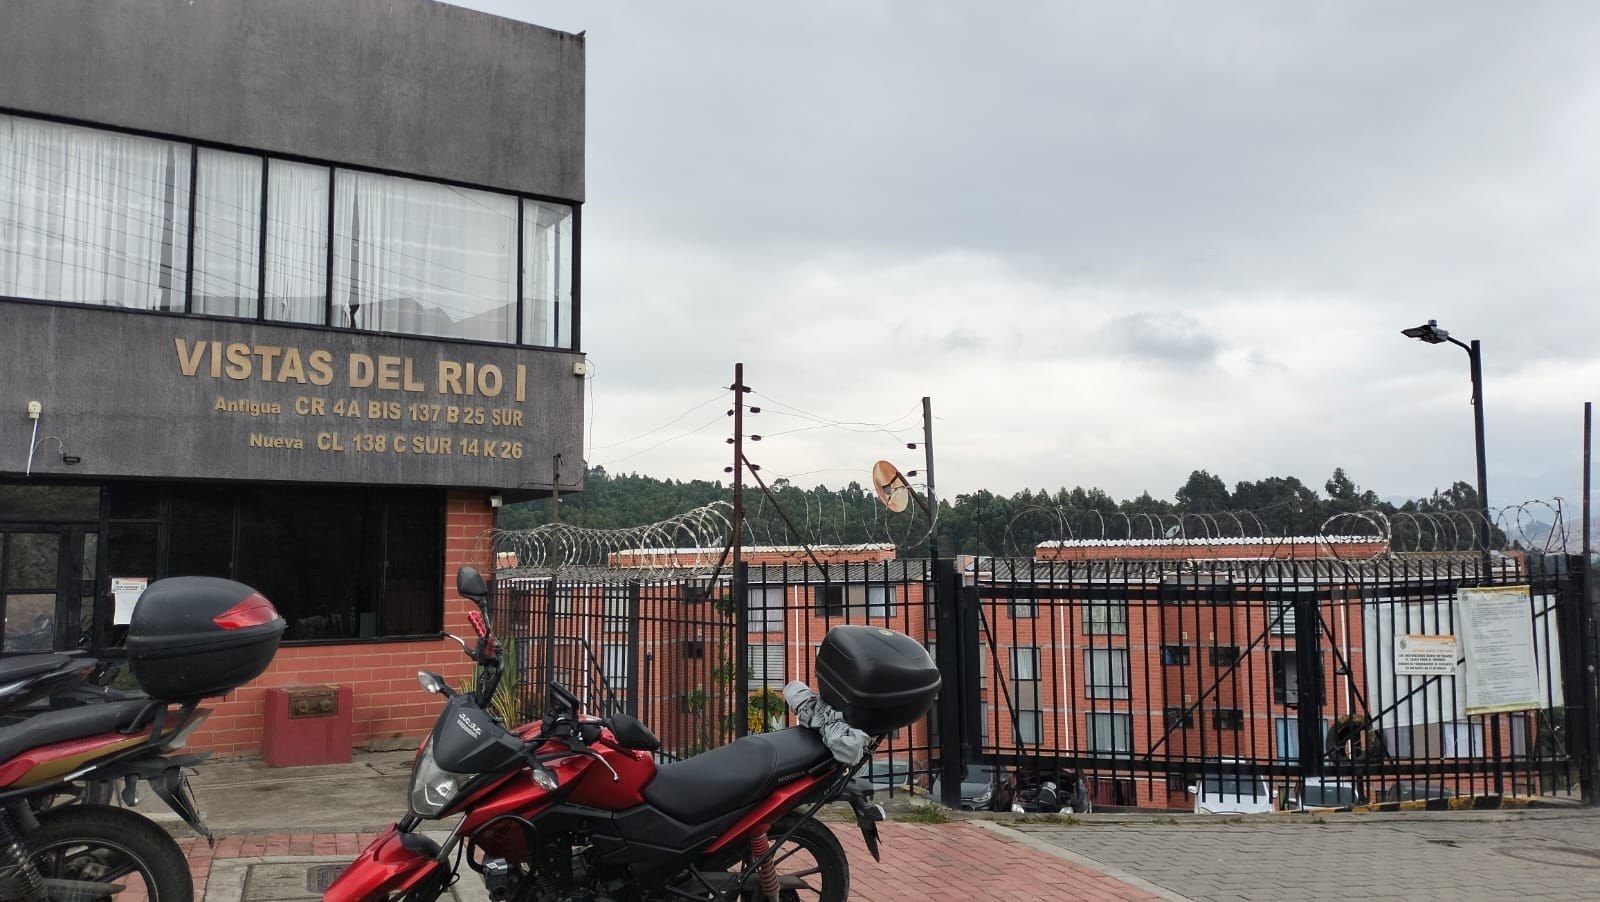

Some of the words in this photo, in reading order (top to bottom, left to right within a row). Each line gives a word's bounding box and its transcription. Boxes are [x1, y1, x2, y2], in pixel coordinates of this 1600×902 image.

[174, 338, 334, 386] VISTAS
[348, 353, 425, 392] DEL
[438, 360, 503, 397] RIO
[515, 364, 527, 402] I
[214, 396, 281, 417] Antigua
[295, 397, 325, 416] CR
[333, 398, 361, 418] 4A
[368, 400, 401, 420] BIS
[409, 403, 442, 422] 137
[447, 405, 459, 424] B
[463, 406, 485, 425] 25
[492, 407, 523, 427] SUR
[249, 432, 304, 449] Nueva
[317, 432, 344, 451] CL
[352, 433, 386, 453] 138
[393, 435, 407, 453] C
[412, 435, 452, 454] SUR
[460, 437, 479, 457] 14
[483, 439, 497, 458] K
[501, 441, 523, 459] 26
